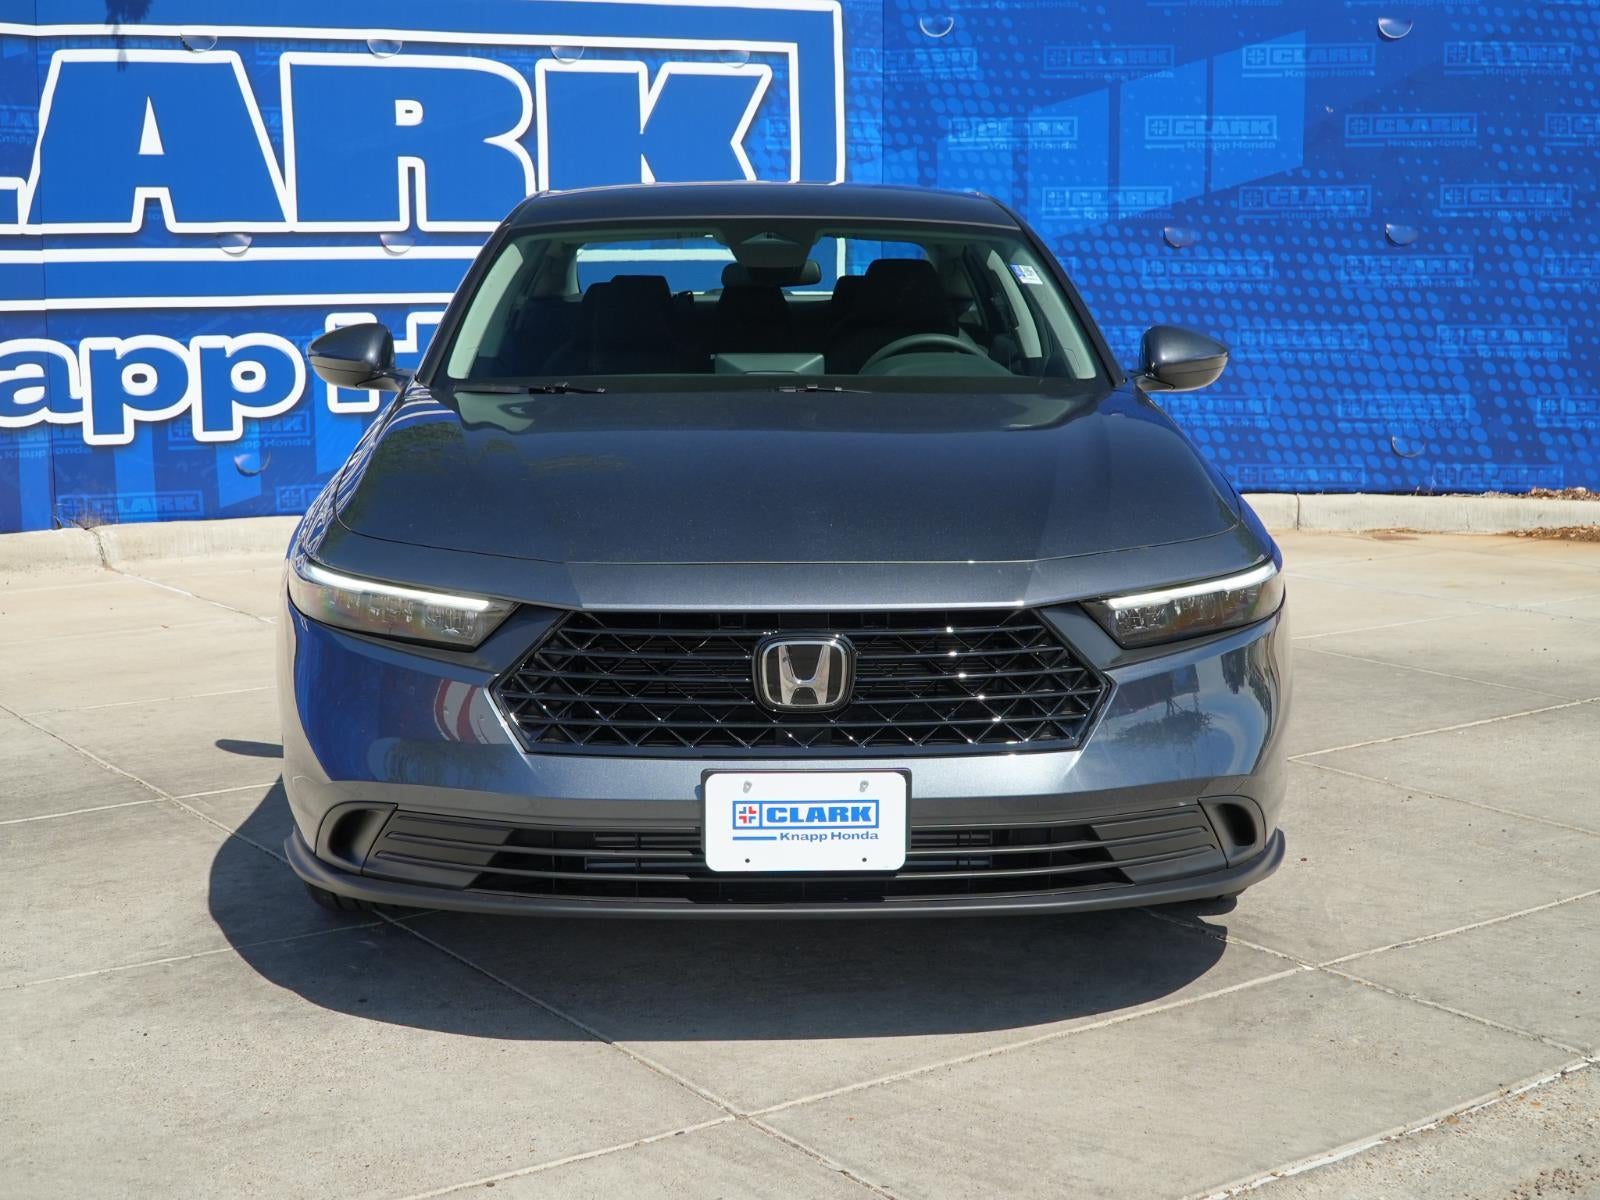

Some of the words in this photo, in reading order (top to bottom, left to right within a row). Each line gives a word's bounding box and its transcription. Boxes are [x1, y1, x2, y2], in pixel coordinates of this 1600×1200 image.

[1272, 48, 1369, 64] CLARK
[1175, 119, 1272, 135] CLARK
[1375, 118, 1472, 134] CLARK
[1072, 191, 1166, 206] CLARK
[766, 806, 872, 823] CLARK
[780, 832, 828, 842] Knapp
[830, 831, 879, 840] Honda
